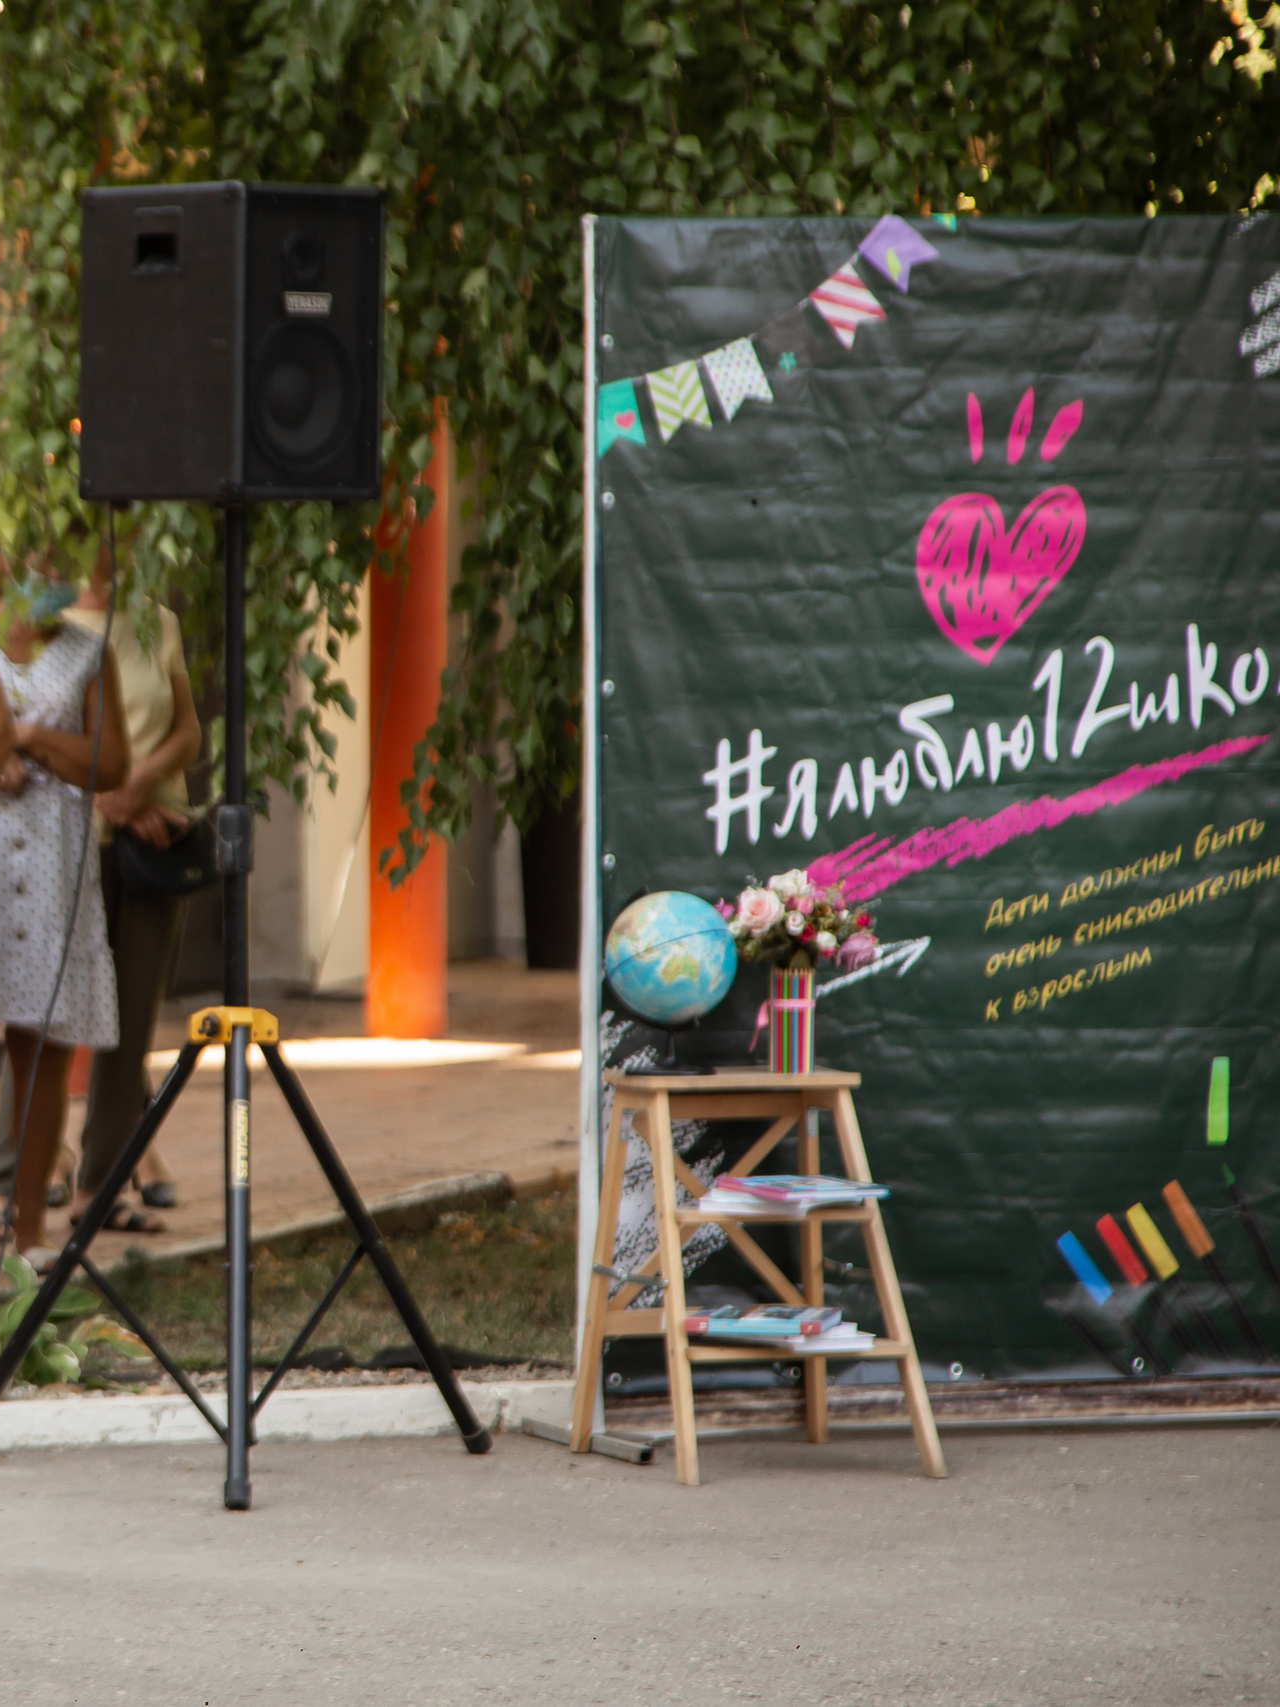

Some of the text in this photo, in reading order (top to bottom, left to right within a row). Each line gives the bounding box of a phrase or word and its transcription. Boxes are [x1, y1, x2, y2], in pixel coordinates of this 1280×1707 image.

[702, 622, 1280, 856] #ялюблю12шко
[983, 817, 1266, 934] Дети должны быть
[984, 934, 1063, 979] очень
[1012, 946, 1152, 1015] взрослым
[233, 1104, 249, 1180] HERCULES
